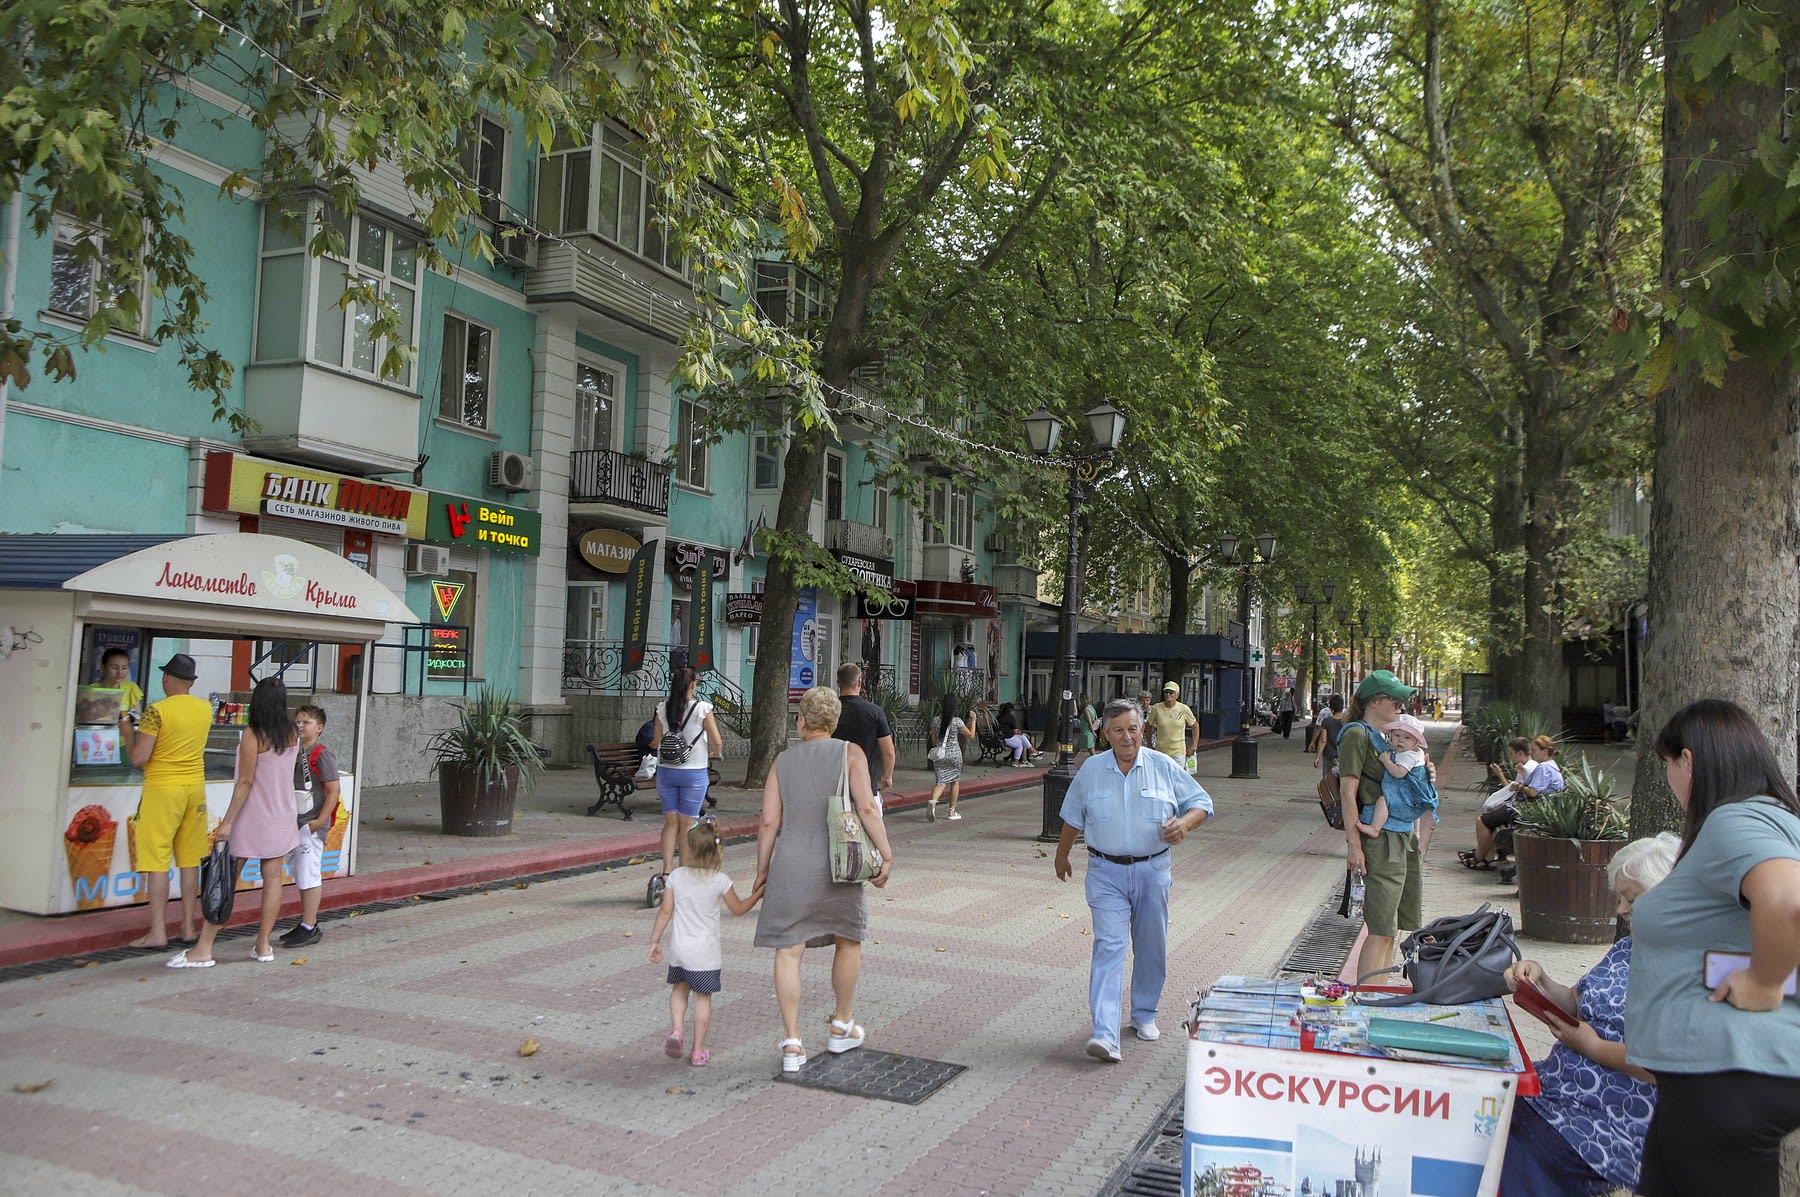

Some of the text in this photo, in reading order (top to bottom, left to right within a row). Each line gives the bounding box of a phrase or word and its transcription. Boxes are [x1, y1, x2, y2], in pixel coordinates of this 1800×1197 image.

[263, 472, 412, 519] БАНК ПИВА
[274, 503, 401, 531] СЕТЬ МАГАЗИНОВ ЖИВОГО ПИВА
[478, 507, 514, 526] Вейп
[478, 529, 529, 548] и точка
[155, 561, 257, 597] Лакомство
[305, 579, 358, 609] Крыма
[432, 628, 459, 638] ТАБАК
[1203, 1066, 1450, 1120] ЭКСКУРСИИ
